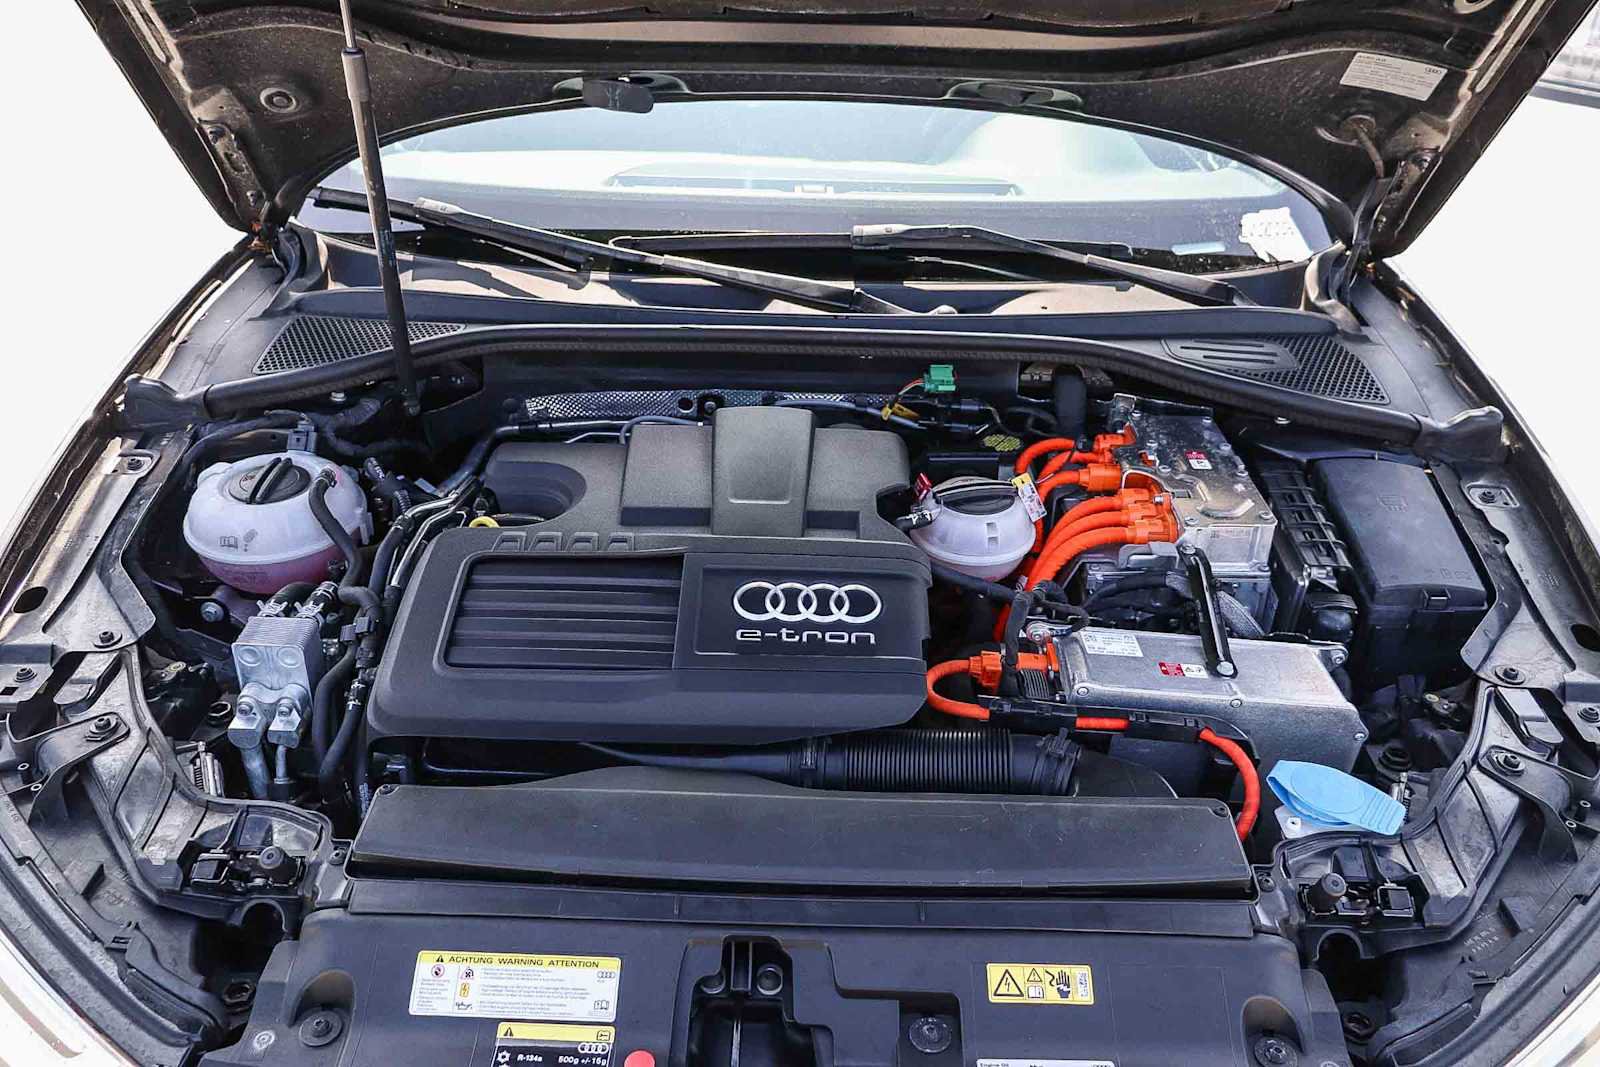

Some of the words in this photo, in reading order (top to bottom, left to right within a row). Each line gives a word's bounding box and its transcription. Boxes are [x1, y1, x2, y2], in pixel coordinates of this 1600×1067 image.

[736, 628, 876, 645] e-tron
[448, 955, 493, 964] ACHTUNG
[498, 958, 543, 966] WARNING
[548, 959, 600, 968] ATTENTION
[517, 1054, 543, 1063] R-134a
